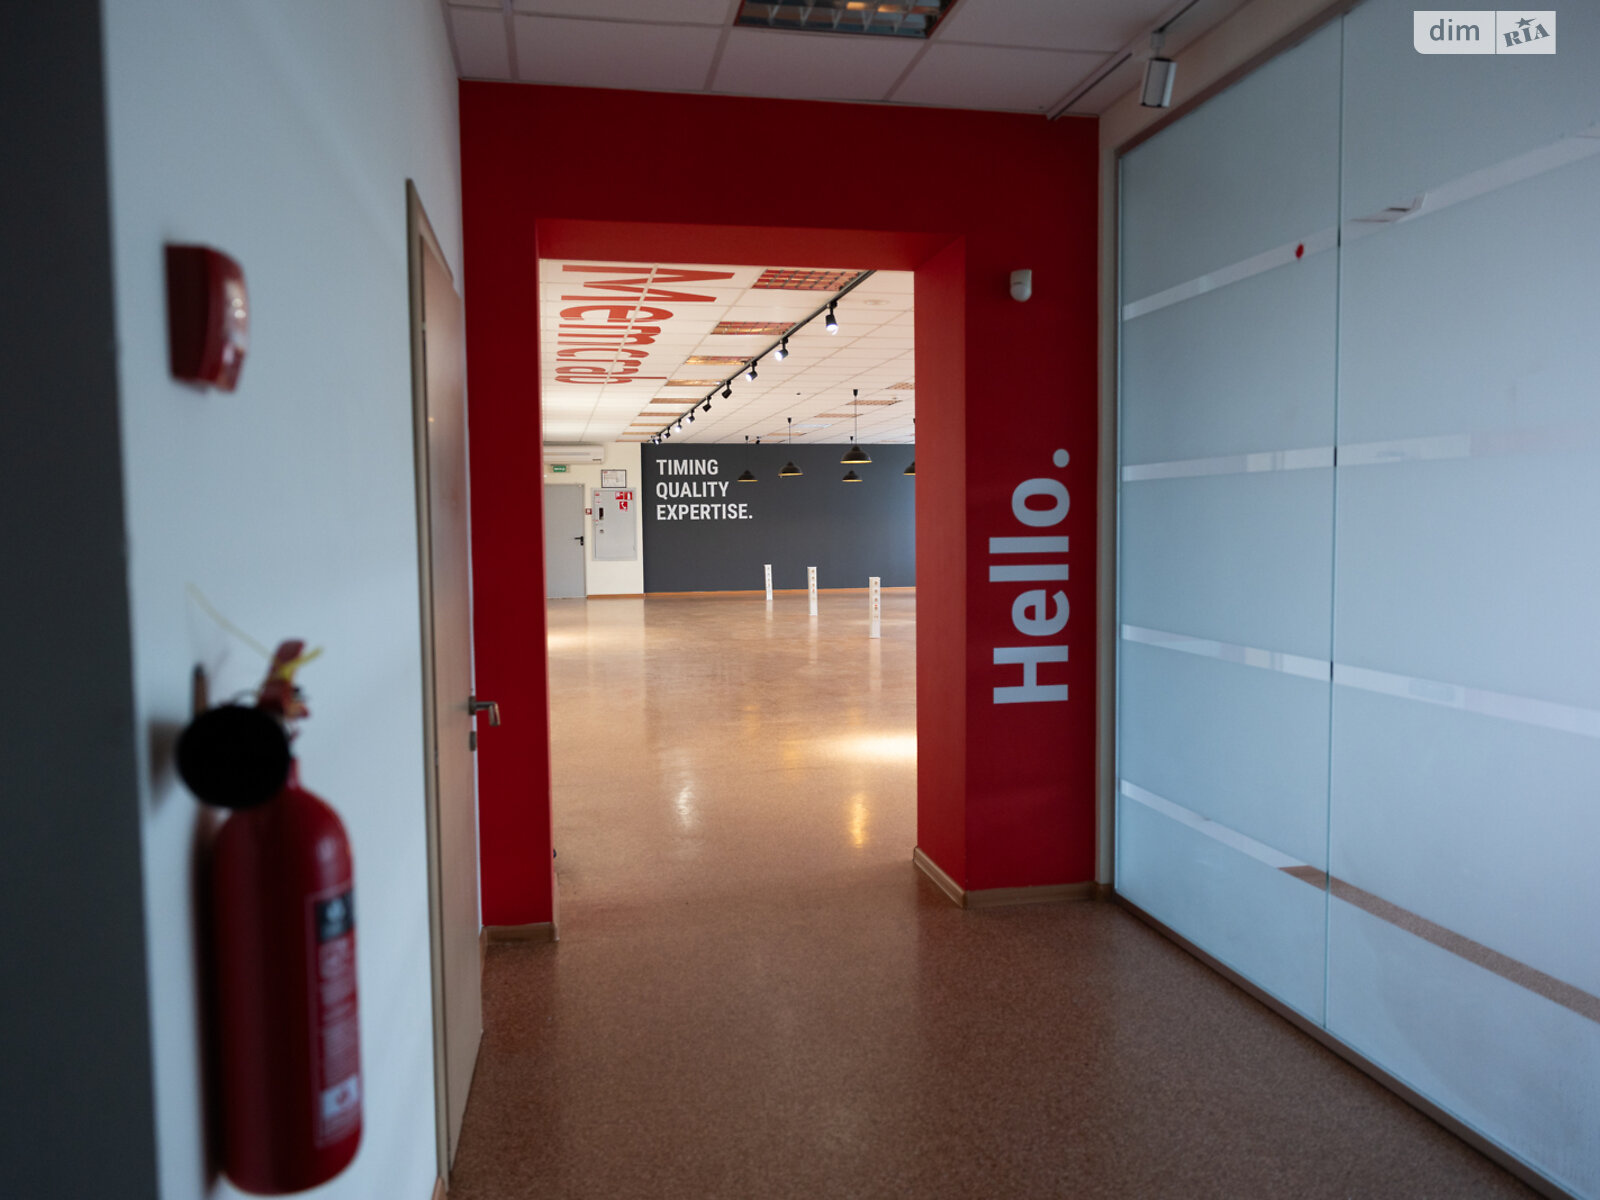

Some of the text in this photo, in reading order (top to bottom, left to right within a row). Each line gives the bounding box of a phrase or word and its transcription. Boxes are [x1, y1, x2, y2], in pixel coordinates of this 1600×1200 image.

[555, 265, 735, 384] Memcrab
[656, 459, 719, 476] TIMING
[656, 481, 729, 500] QUALITY
[656, 503, 753, 520] EXPERTISE.
[988, 448, 1071, 704] Hello.
